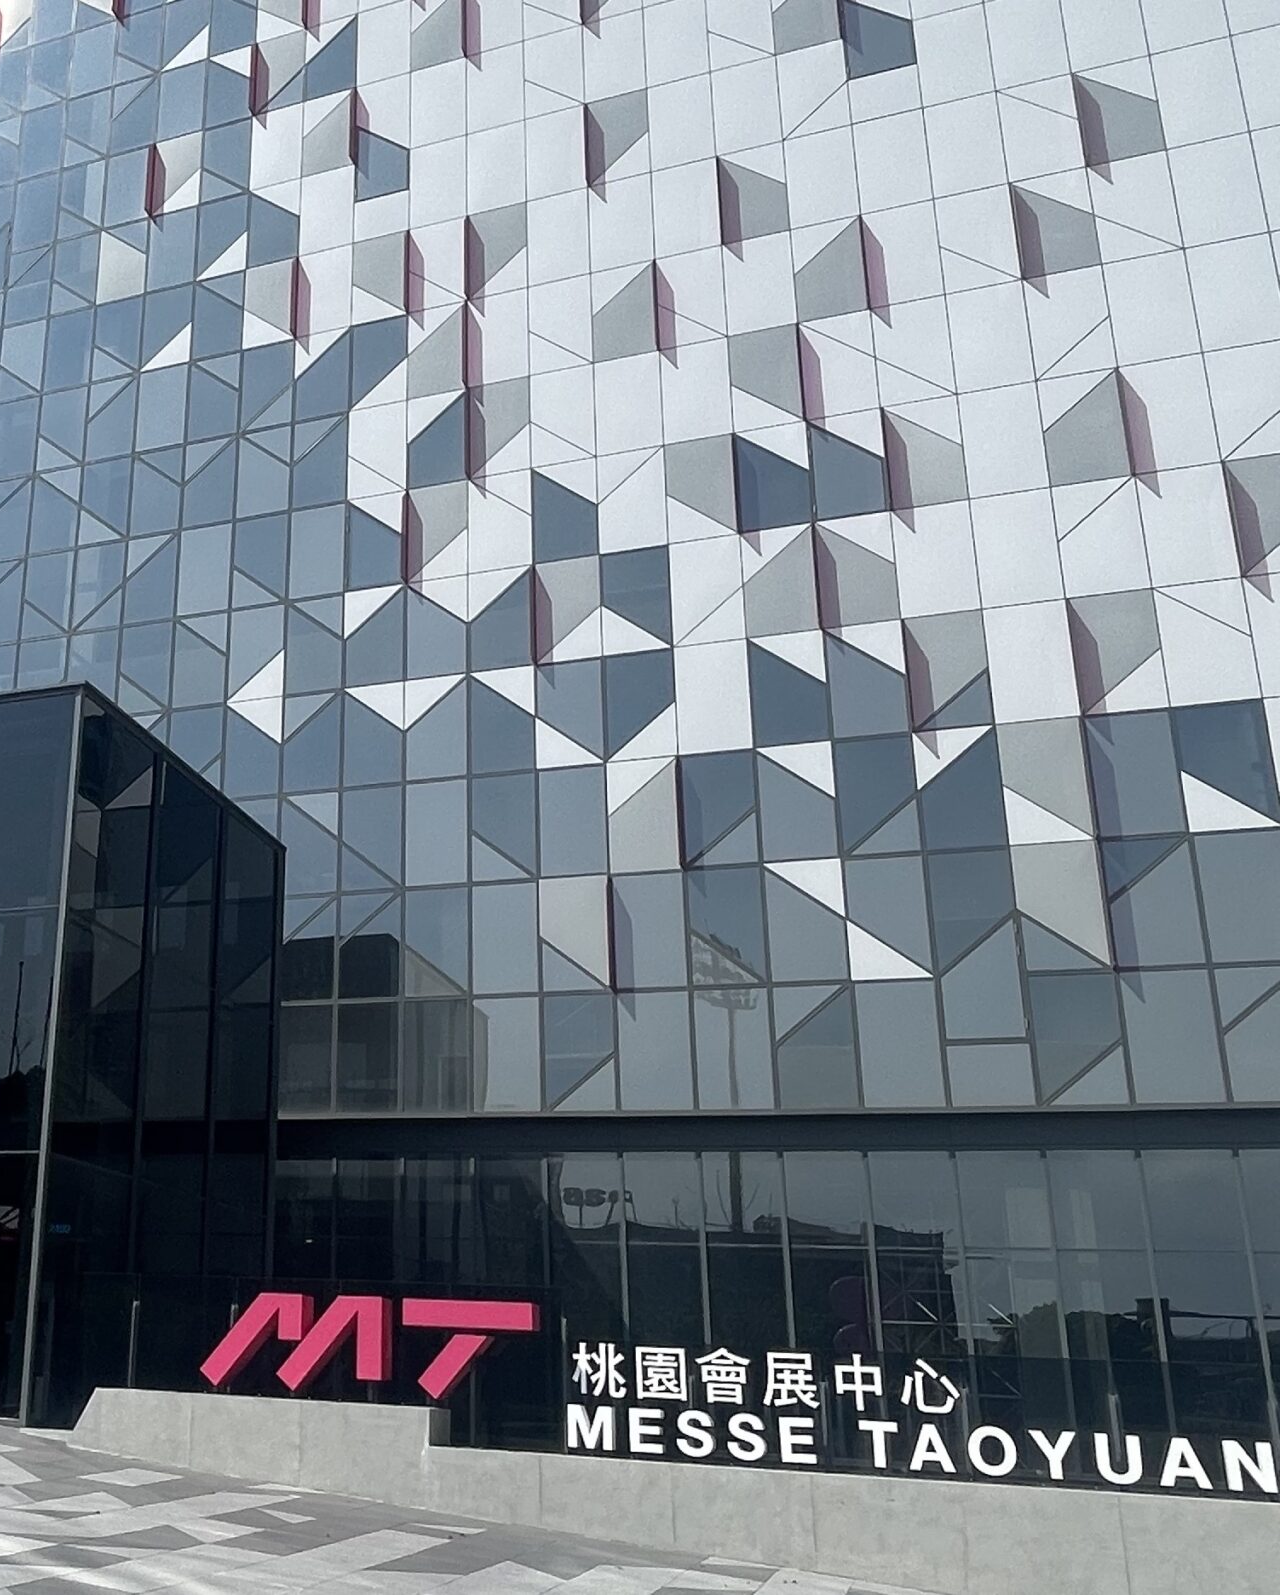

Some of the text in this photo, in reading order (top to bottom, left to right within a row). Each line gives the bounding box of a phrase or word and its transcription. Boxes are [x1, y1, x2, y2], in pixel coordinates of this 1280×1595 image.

[571, 1342, 961, 1416] 桃園會展中心
[566, 1403, 1280, 1495] MESSE TAOYUAN
